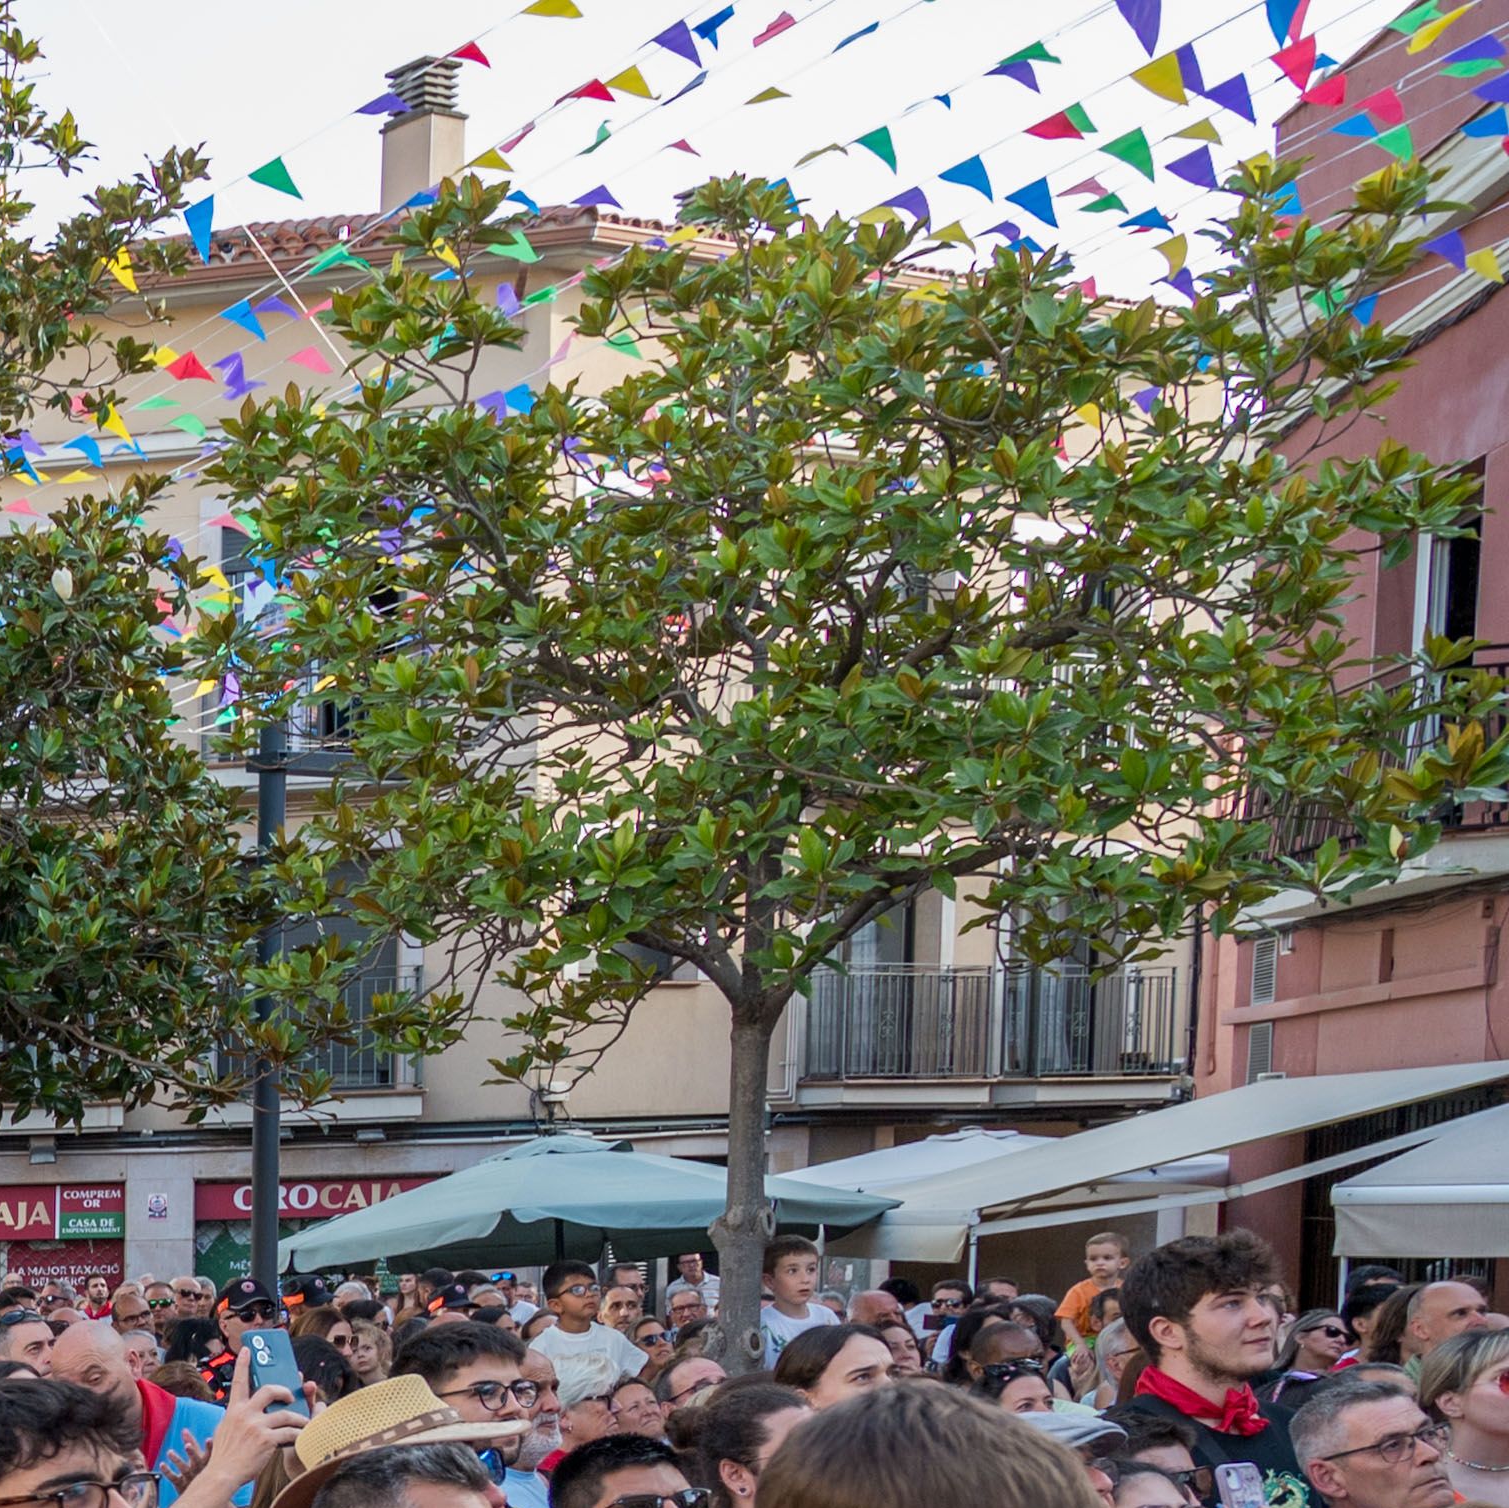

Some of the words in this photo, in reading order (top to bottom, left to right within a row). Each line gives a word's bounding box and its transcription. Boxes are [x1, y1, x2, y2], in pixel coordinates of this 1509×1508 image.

[63, 1189, 121, 1200] COMPREM
[83, 1199, 101, 1209] OR
[69, 1217, 97, 1228] CASA
[100, 1217, 115, 1228] DE
[27, 1266, 67, 1277] MAJOR
[69, 1262, 120, 1275] TAXACIÓ
